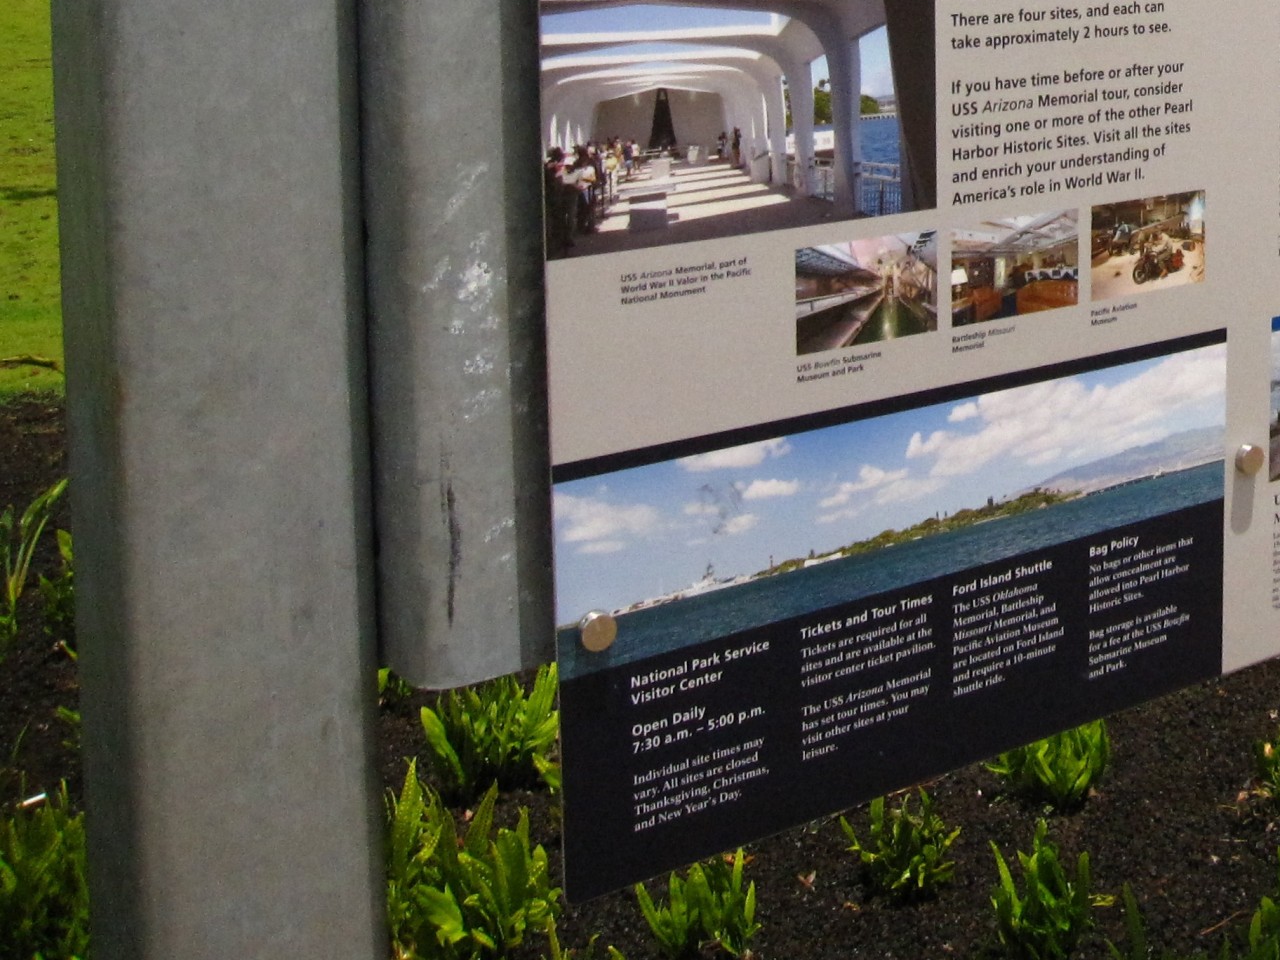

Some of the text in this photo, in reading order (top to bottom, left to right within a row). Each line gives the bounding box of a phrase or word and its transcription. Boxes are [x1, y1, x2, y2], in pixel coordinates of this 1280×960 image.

[950, 1, 1164, 26] There are four sites, and each can
[950, 22, 1171, 49] take approximately 2 hours to see.
[951, 62, 1184, 97] If you have time before or after your
[951, 81, 1183, 117] USS Arizona Memorial tour, consider
[951, 99, 1193, 138] visiting one or more of the other Pearl
[952, 122, 1191, 160] Harbor Historic Sites. Visit all the sites
[951, 142, 1166, 183] and enrich your understanding of
[952, 167, 1144, 205] America's role in World War II.
[620, 272, 638, 283] USS
[639, 269, 673, 279] Arizona
[718, 259, 736, 272] part
[737, 256, 747, 270] of
[1089, 536, 1139, 557] Bag Policy
[952, 560, 1052, 596] Ford Island Shuttle
[800, 595, 933, 639] Tickets and Tour Times
[630, 641, 769, 687] National Park Service
[631, 671, 723, 704] Visitor Center
[631, 706, 706, 736] Open Daily
[632, 735, 660, 753] 7:30
[664, 729, 692, 744] a.m.
[707, 712, 734, 730] 5:00
[738, 706, 765, 724] p.m.
[633, 738, 764, 785] Individual site times may
[633, 751, 758, 800] vary. All sites are closed
[634, 767, 769, 815] Thanksgiving, Christmas,
[634, 790, 742, 832] and New Year's Day.
